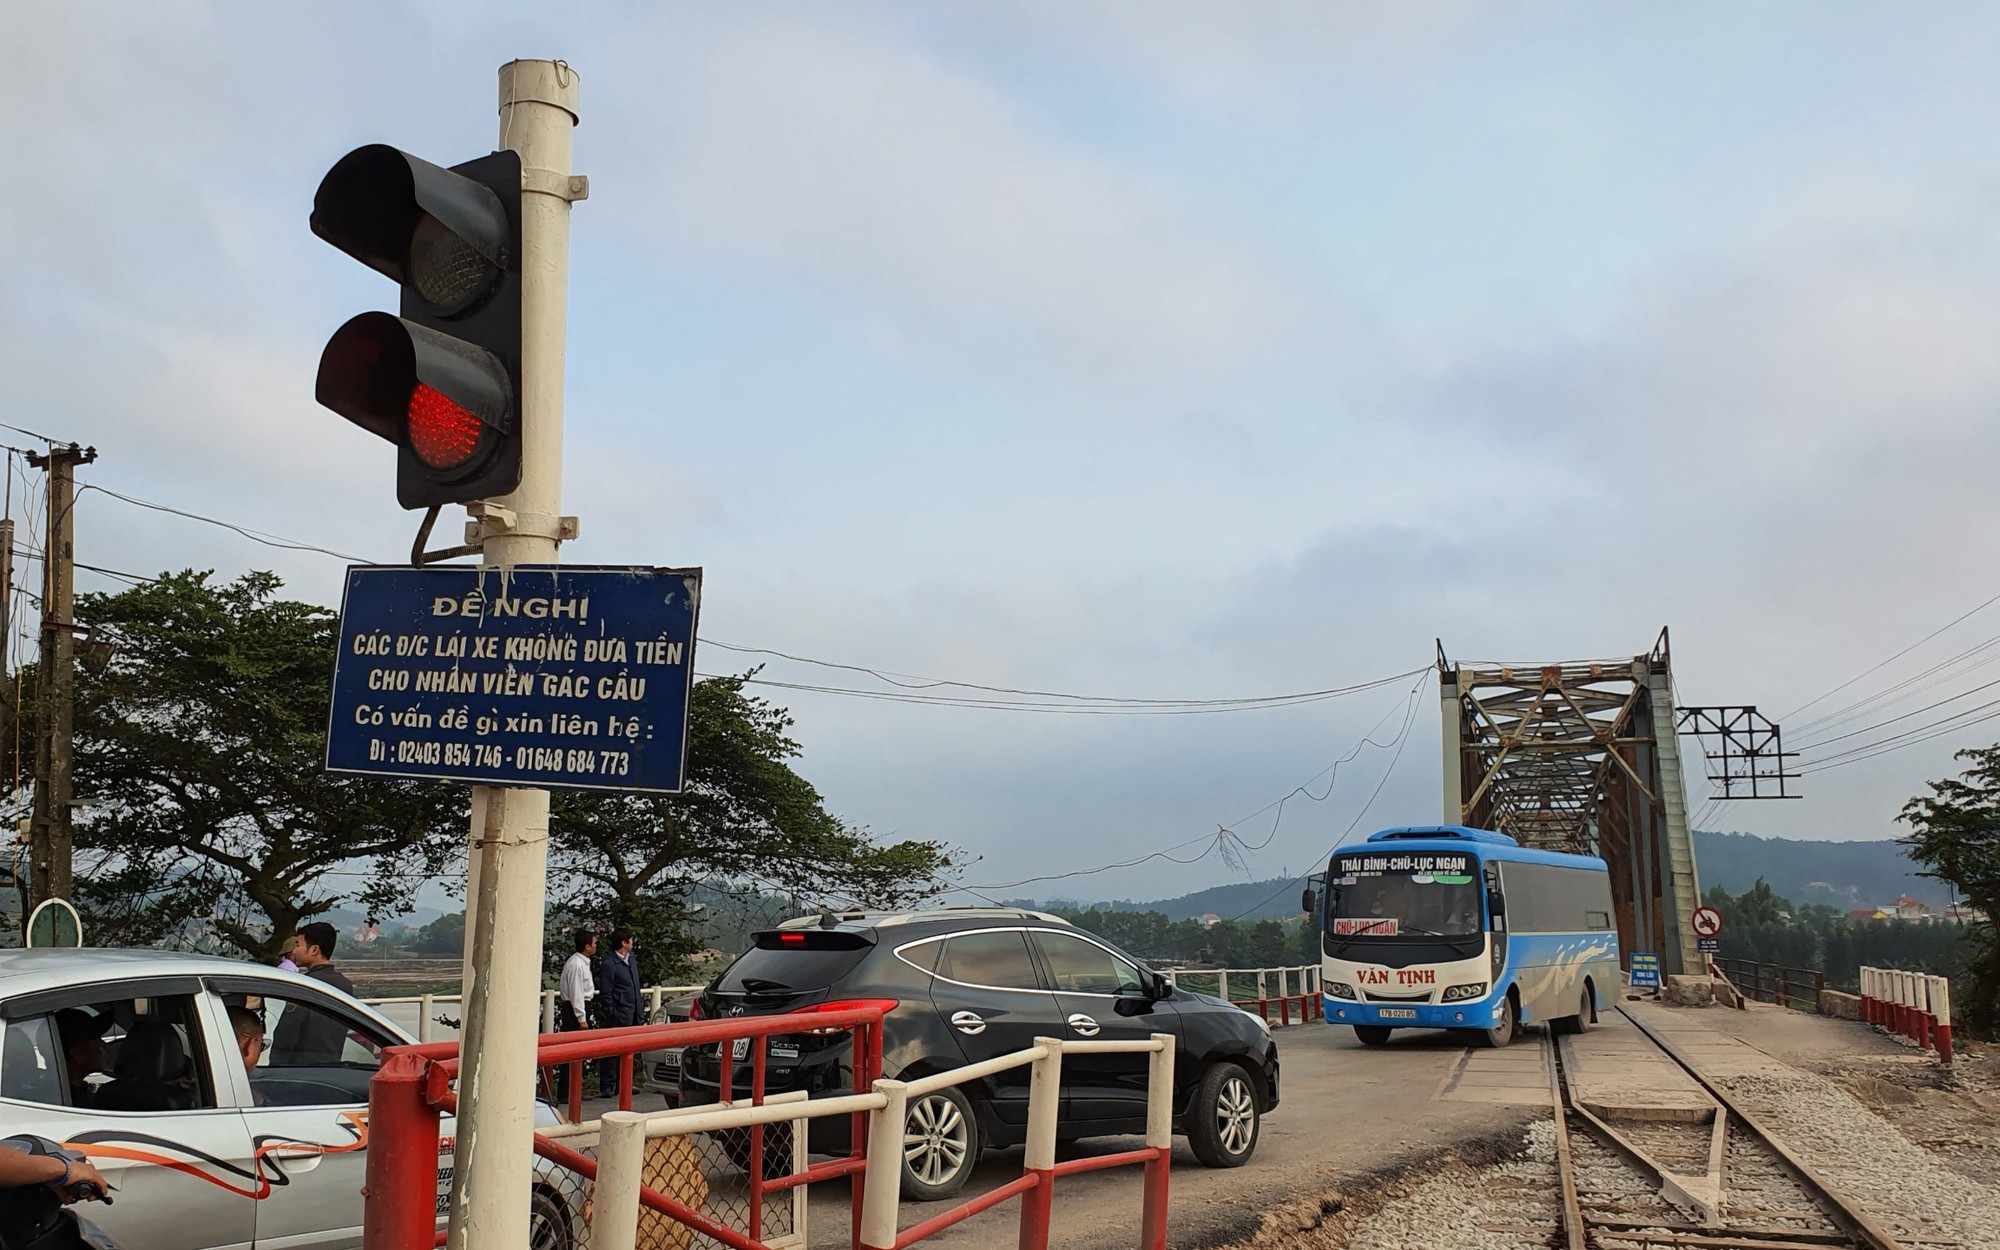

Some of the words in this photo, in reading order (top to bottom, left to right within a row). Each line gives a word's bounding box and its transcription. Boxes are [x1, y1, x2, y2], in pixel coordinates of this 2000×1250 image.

[494, 597, 589, 625] NGHỊ
[353, 628, 391, 655] CÁC
[396, 635, 429, 657] Đ/C
[435, 629, 467, 658] LÁI
[471, 636, 499, 658] XE
[504, 633, 577, 662] KHÔNG
[584, 637, 627, 663] ĐƯA
[635, 631, 683, 665] TIỀN
[368, 668, 409, 690] CHO
[415, 666, 477, 693] NHÂN
[543, 669, 590, 698] GÁC
[597, 668, 646, 701] CẦU
[355, 704, 384, 725] Có
[390, 702, 432, 728] vấn
[439, 705, 469, 729] đề
[476, 707, 498, 735] gì
[504, 712, 543, 733] xin
[551, 713, 598, 736] liên
[608, 716, 640, 743] hệ
[398, 742, 441, 765] 02403
[444, 743, 471, 767] 854
[474, 744, 503, 768] 746
[516, 747, 563, 772] 01648
[566, 751, 596, 773] 684
[600, 751, 630, 776] 773
[1341, 857, 1361, 872] THÁI
[1436, 857, 1466, 871] NGẠN
[1357, 967, 1389, 984] VĂN
[1397, 970, 1435, 987] TỊNH
